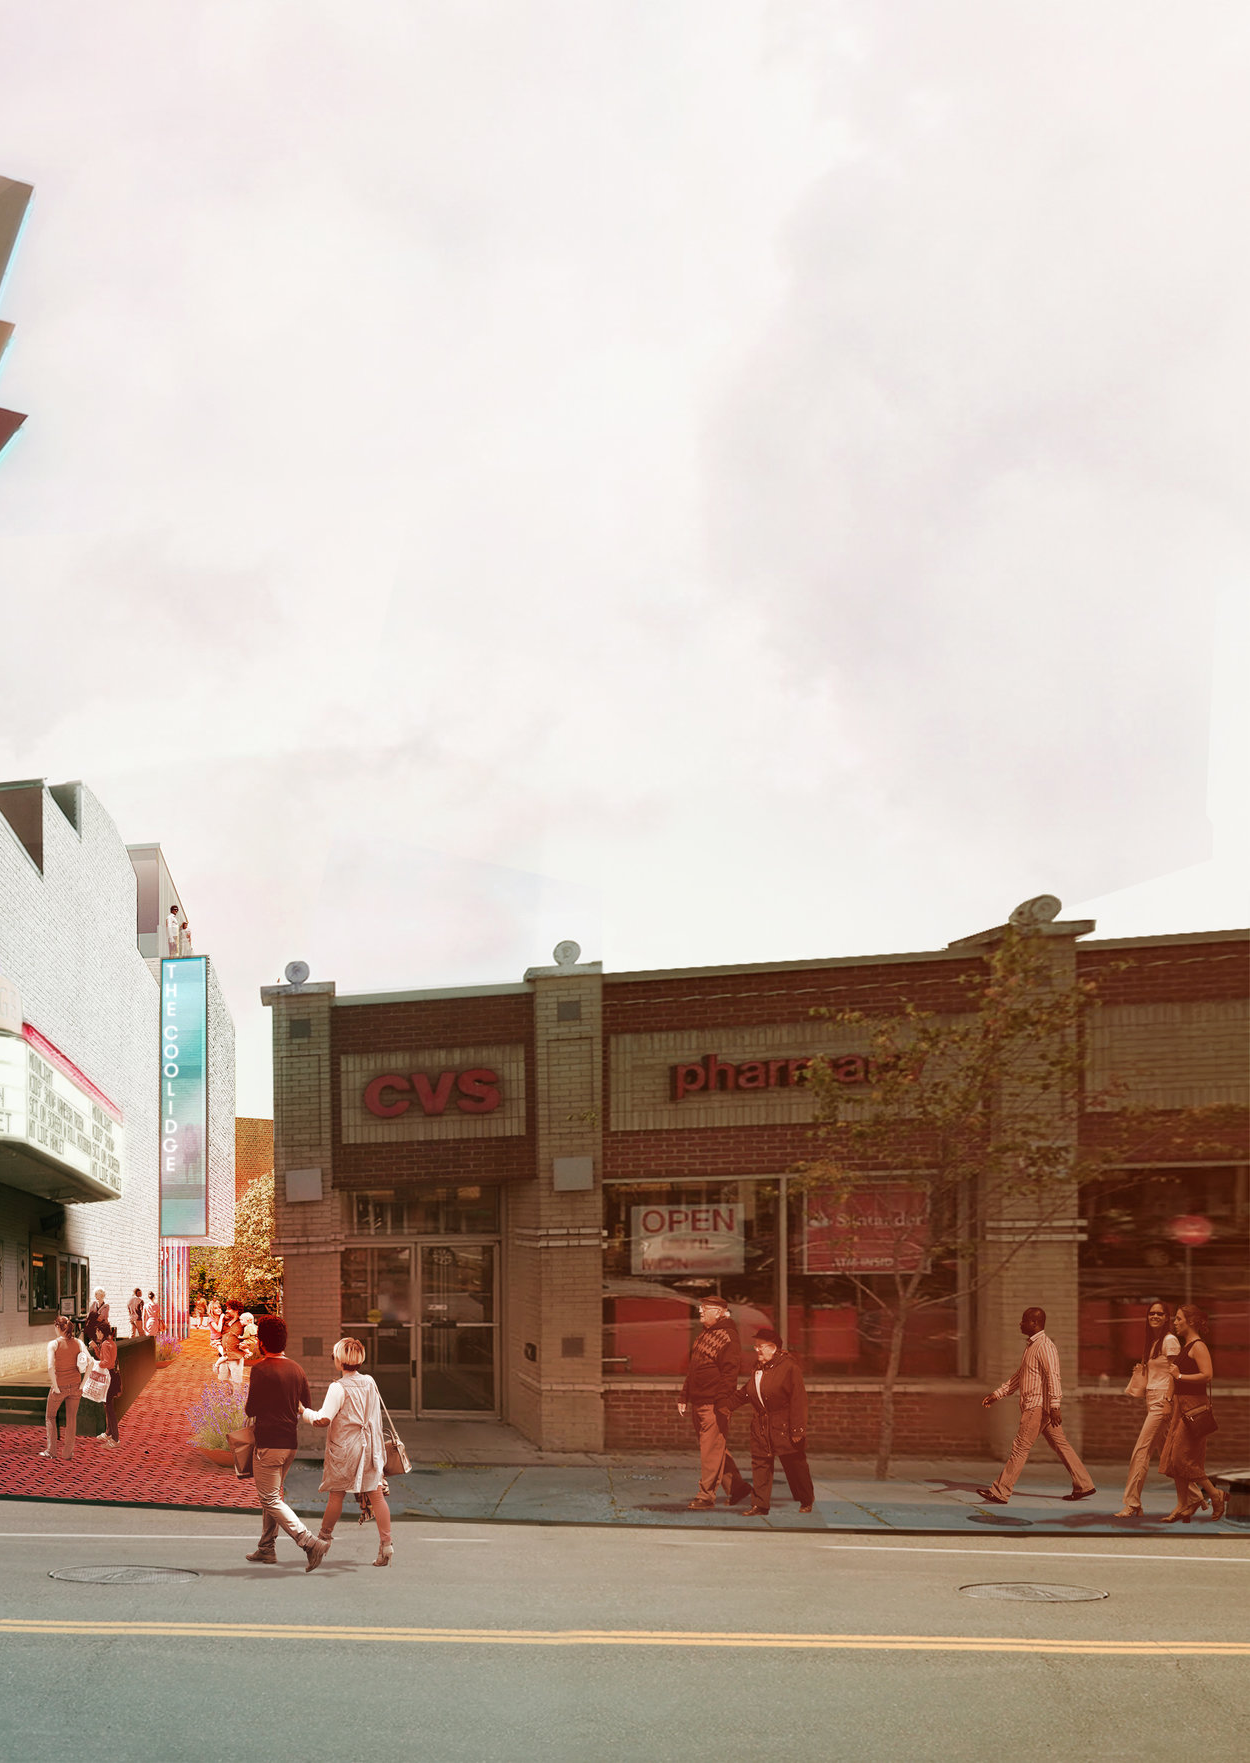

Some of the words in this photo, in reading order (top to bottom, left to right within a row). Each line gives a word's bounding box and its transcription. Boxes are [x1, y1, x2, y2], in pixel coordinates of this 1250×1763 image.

[164, 963, 178, 1017] THE
[163, 1025, 179, 1172] COOLIDGE
[362, 1068, 503, 1118] CVS
[642, 1208, 735, 1233] OPEN
